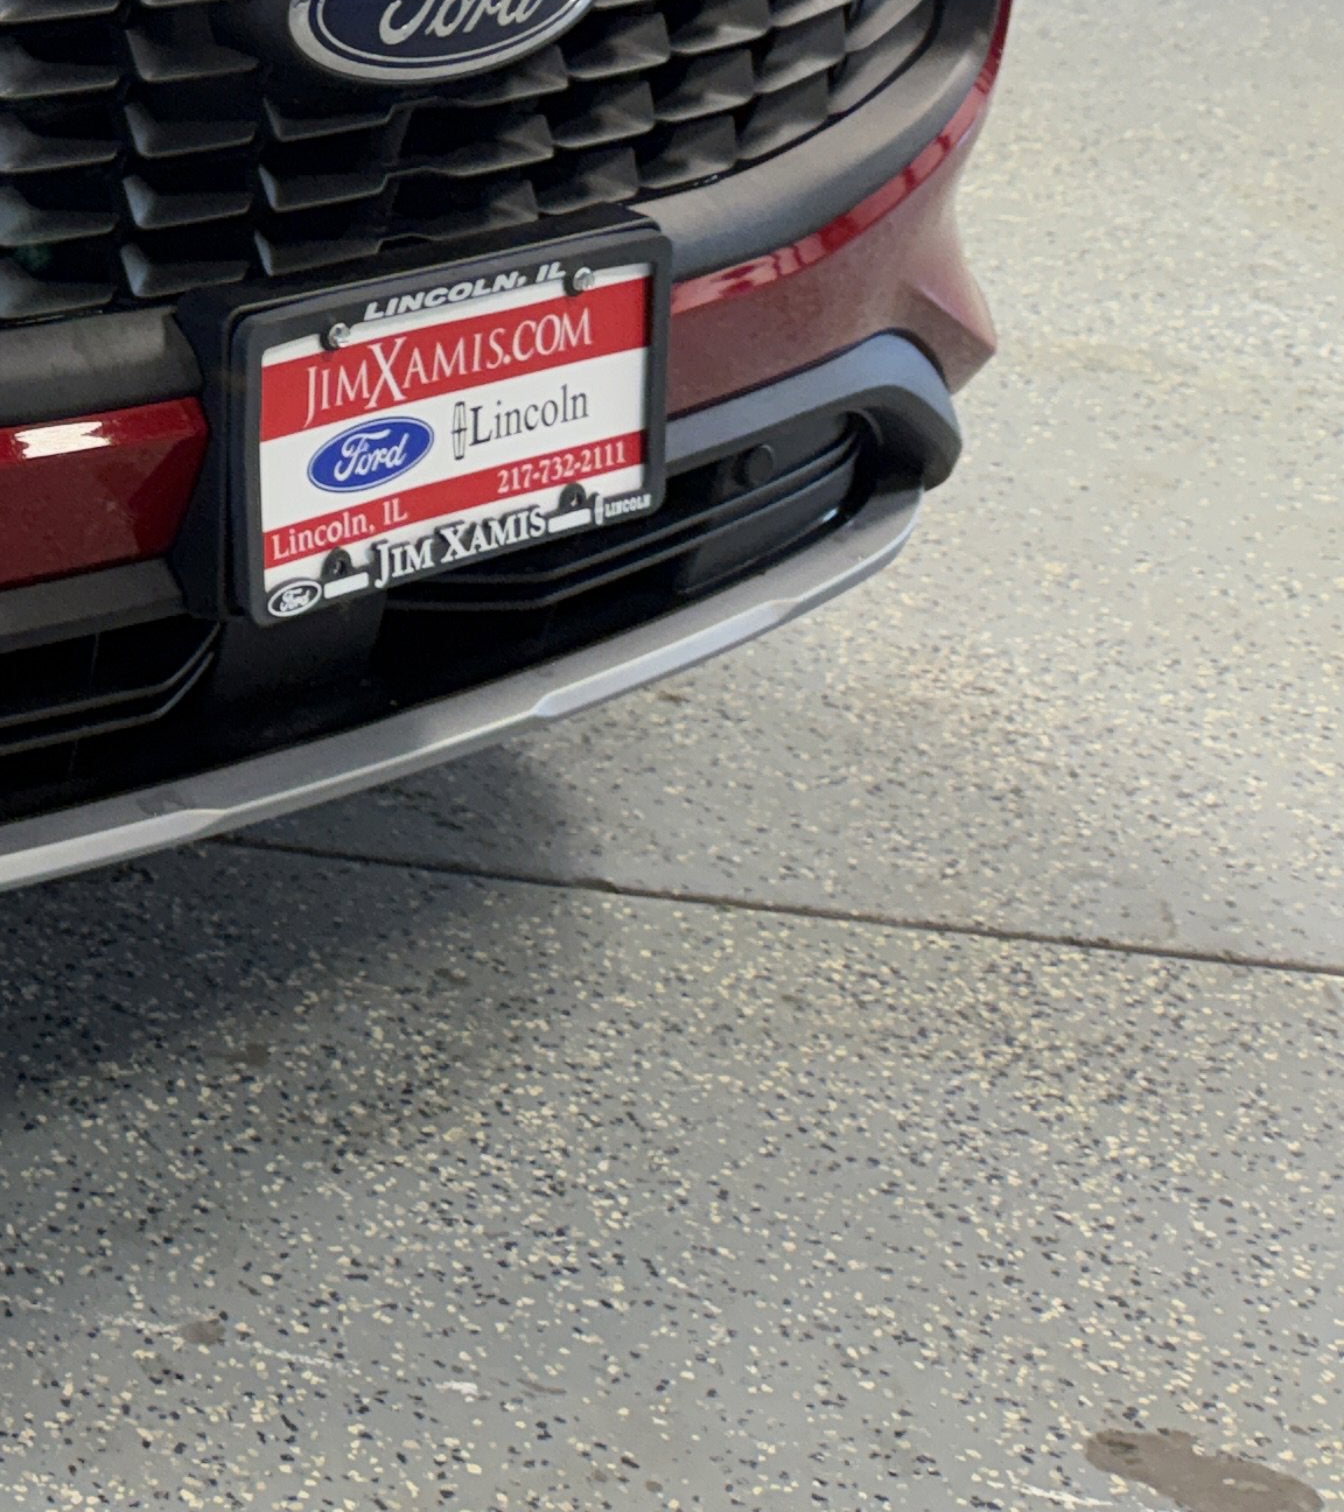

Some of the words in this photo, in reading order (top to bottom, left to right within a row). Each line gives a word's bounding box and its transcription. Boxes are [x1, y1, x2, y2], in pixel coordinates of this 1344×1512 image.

[363, 270, 528, 322] LINCOLN,
[535, 261, 567, 284] IL
[468, 383, 590, 447] Lincoln
[332, 428, 410, 482] Ford
[496, 440, 627, 495] 217-732-2111
[271, 511, 376, 561] Lincoln,
[382, 497, 409, 526] IL
[373, 538, 436, 589] JIM
[439, 506, 547, 564] XAMIS
[279, 587, 310, 612] Ford
